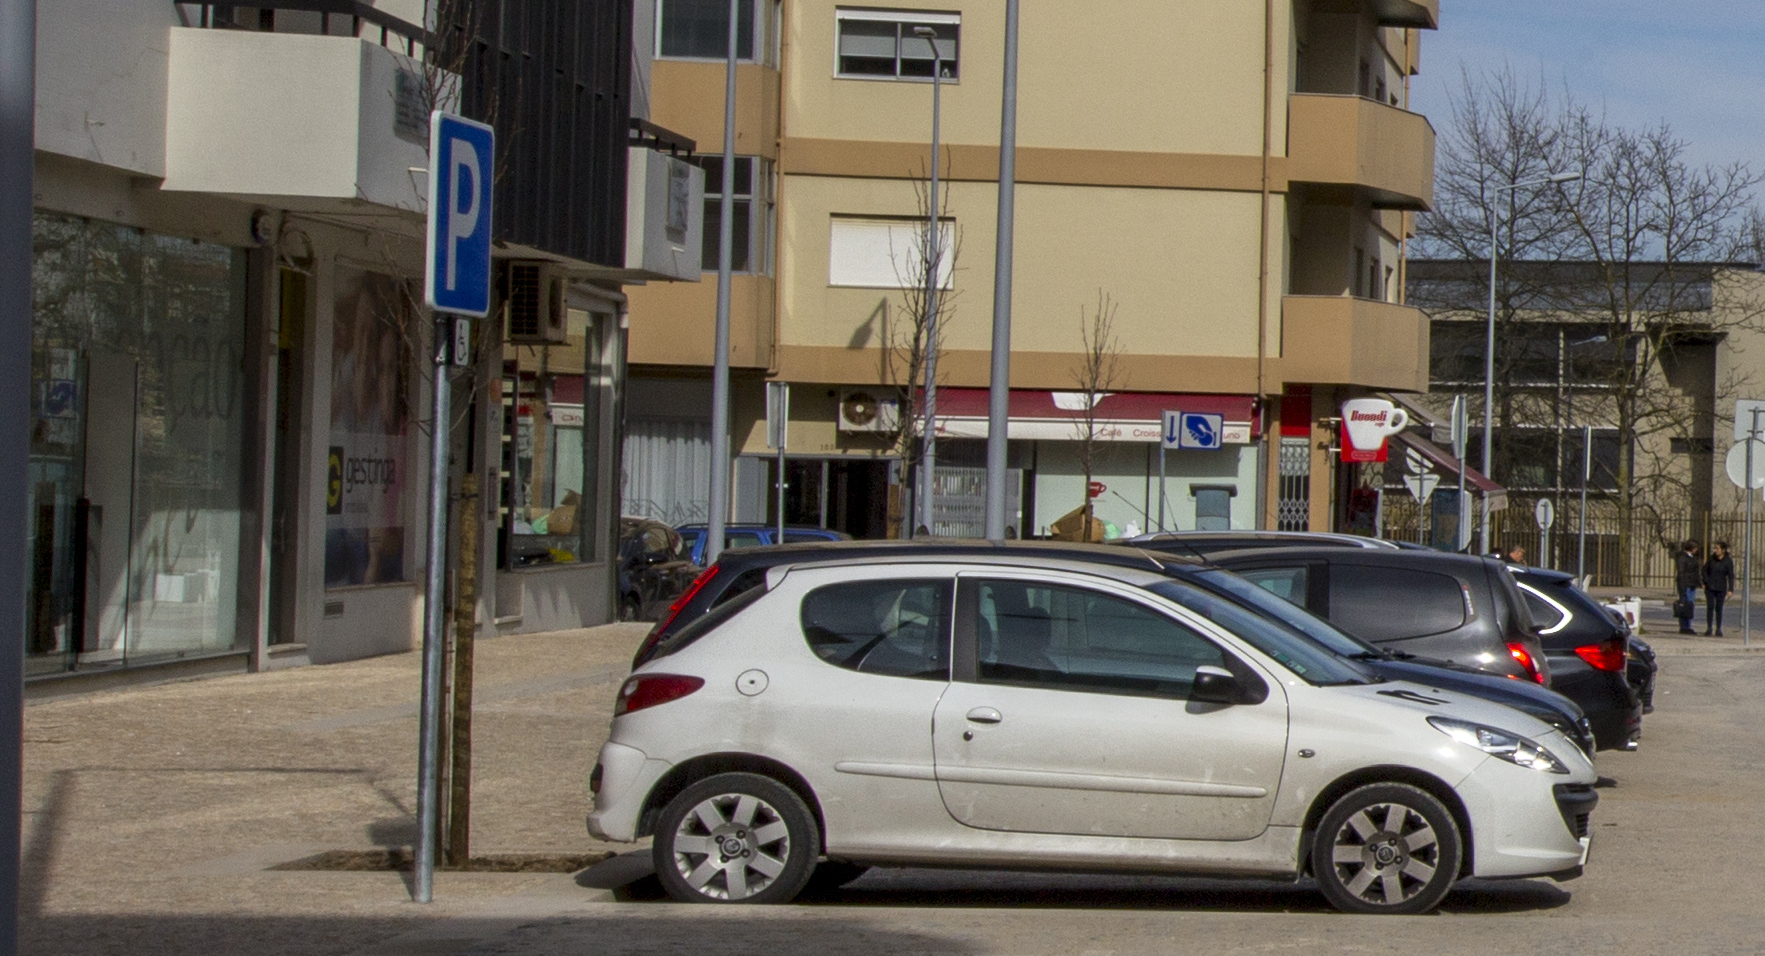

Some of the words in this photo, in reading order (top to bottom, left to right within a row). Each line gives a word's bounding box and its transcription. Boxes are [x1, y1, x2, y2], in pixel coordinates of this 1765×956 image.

[446, 137, 481, 291] P
[1351, 410, 1388, 421] Buondi
[1101, 428, 1122, 437] Café
[1133, 428, 1162, 438] Croiss
